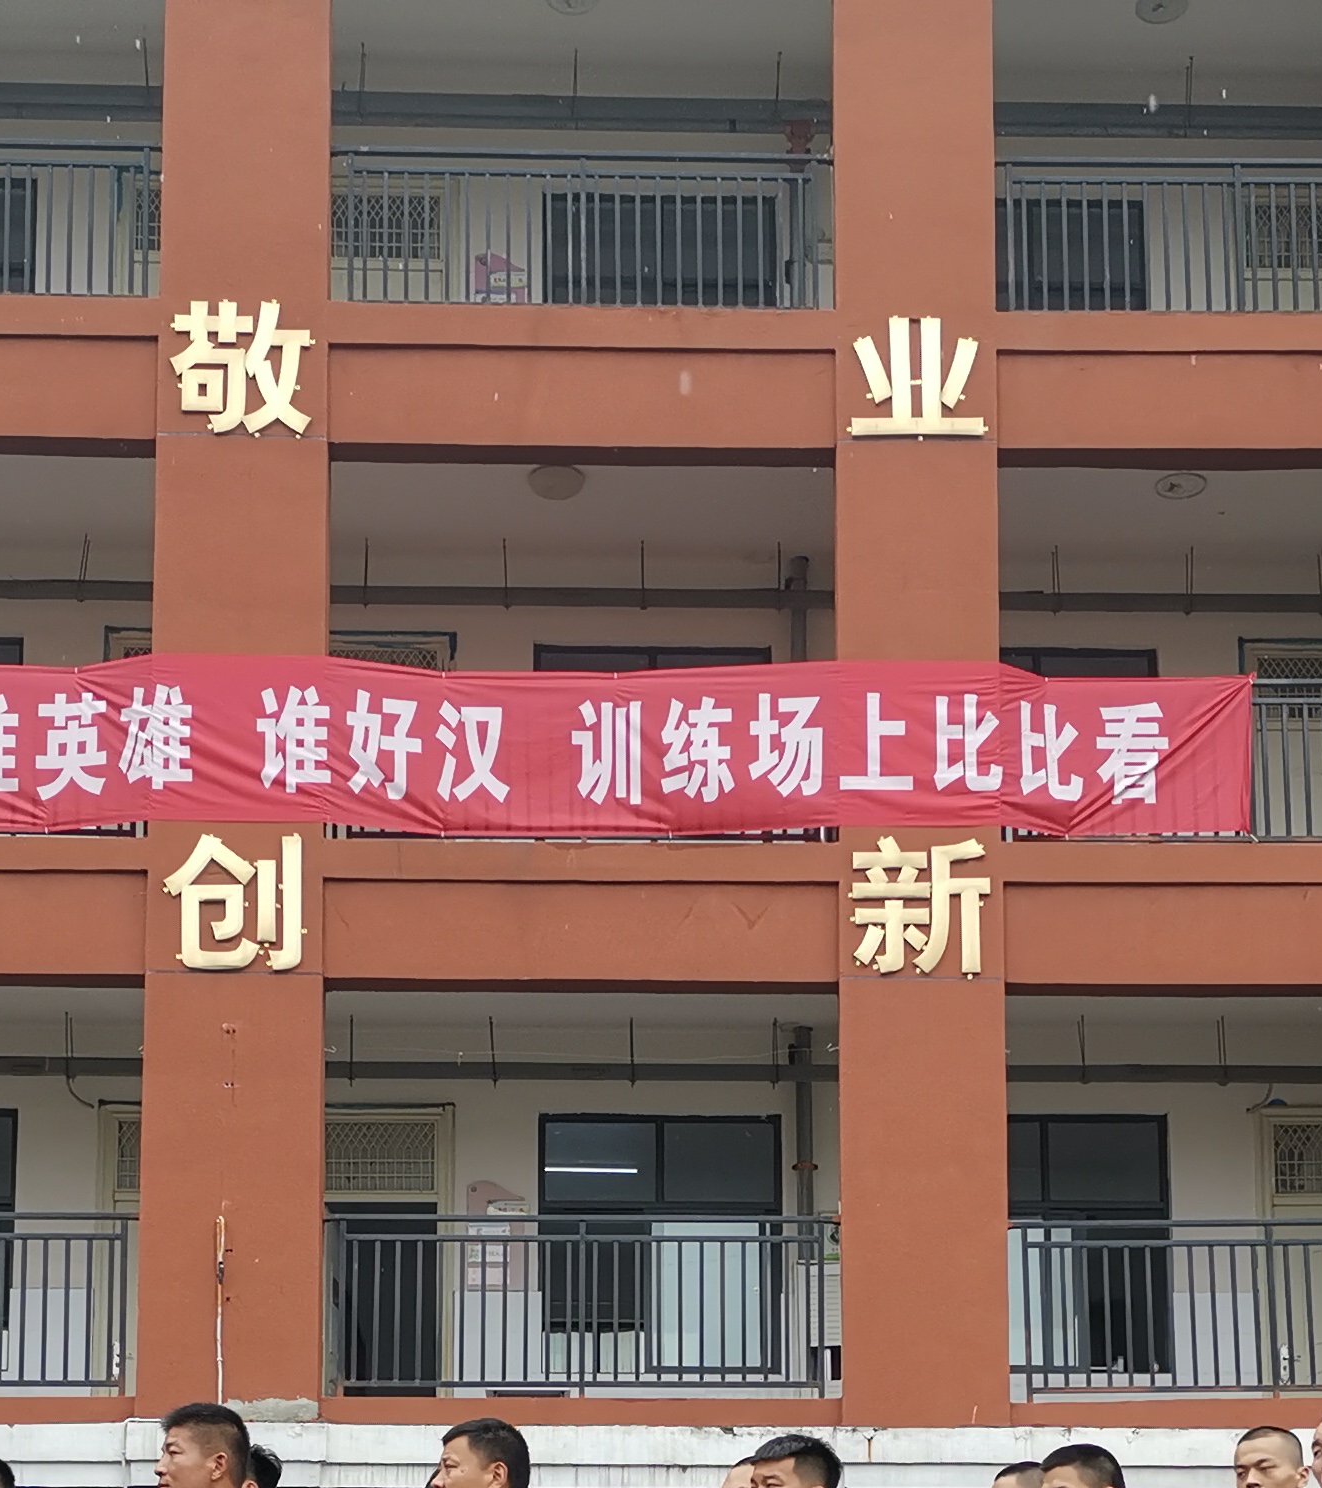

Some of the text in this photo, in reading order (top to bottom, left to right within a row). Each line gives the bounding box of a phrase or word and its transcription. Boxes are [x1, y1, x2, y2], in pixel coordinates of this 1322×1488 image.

[170, 299, 311, 434] 敬
[849, 315, 988, 435] 业
[257, 686, 510, 803] 谁好汉
[572, 693, 1169, 804] 训练场上比比看
[163, 833, 305, 970] 创
[848, 836, 990, 974] 新
